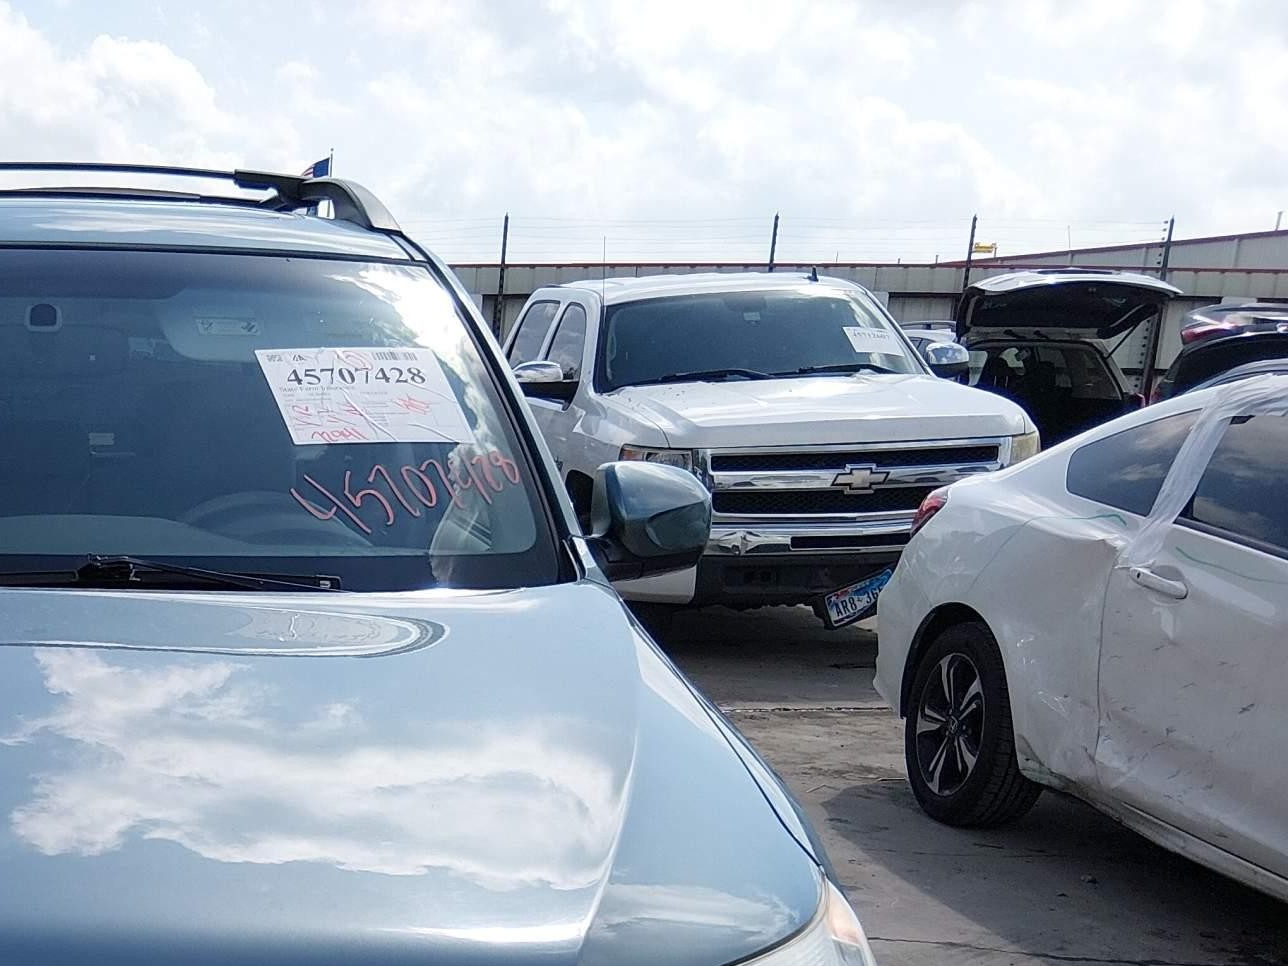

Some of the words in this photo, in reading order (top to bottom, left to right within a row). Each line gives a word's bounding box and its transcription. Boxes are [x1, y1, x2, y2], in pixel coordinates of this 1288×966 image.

[286, 366, 426, 386] 45707428
[289, 449, 521, 535] 45707428
[834, 596, 858, 617] AR8
